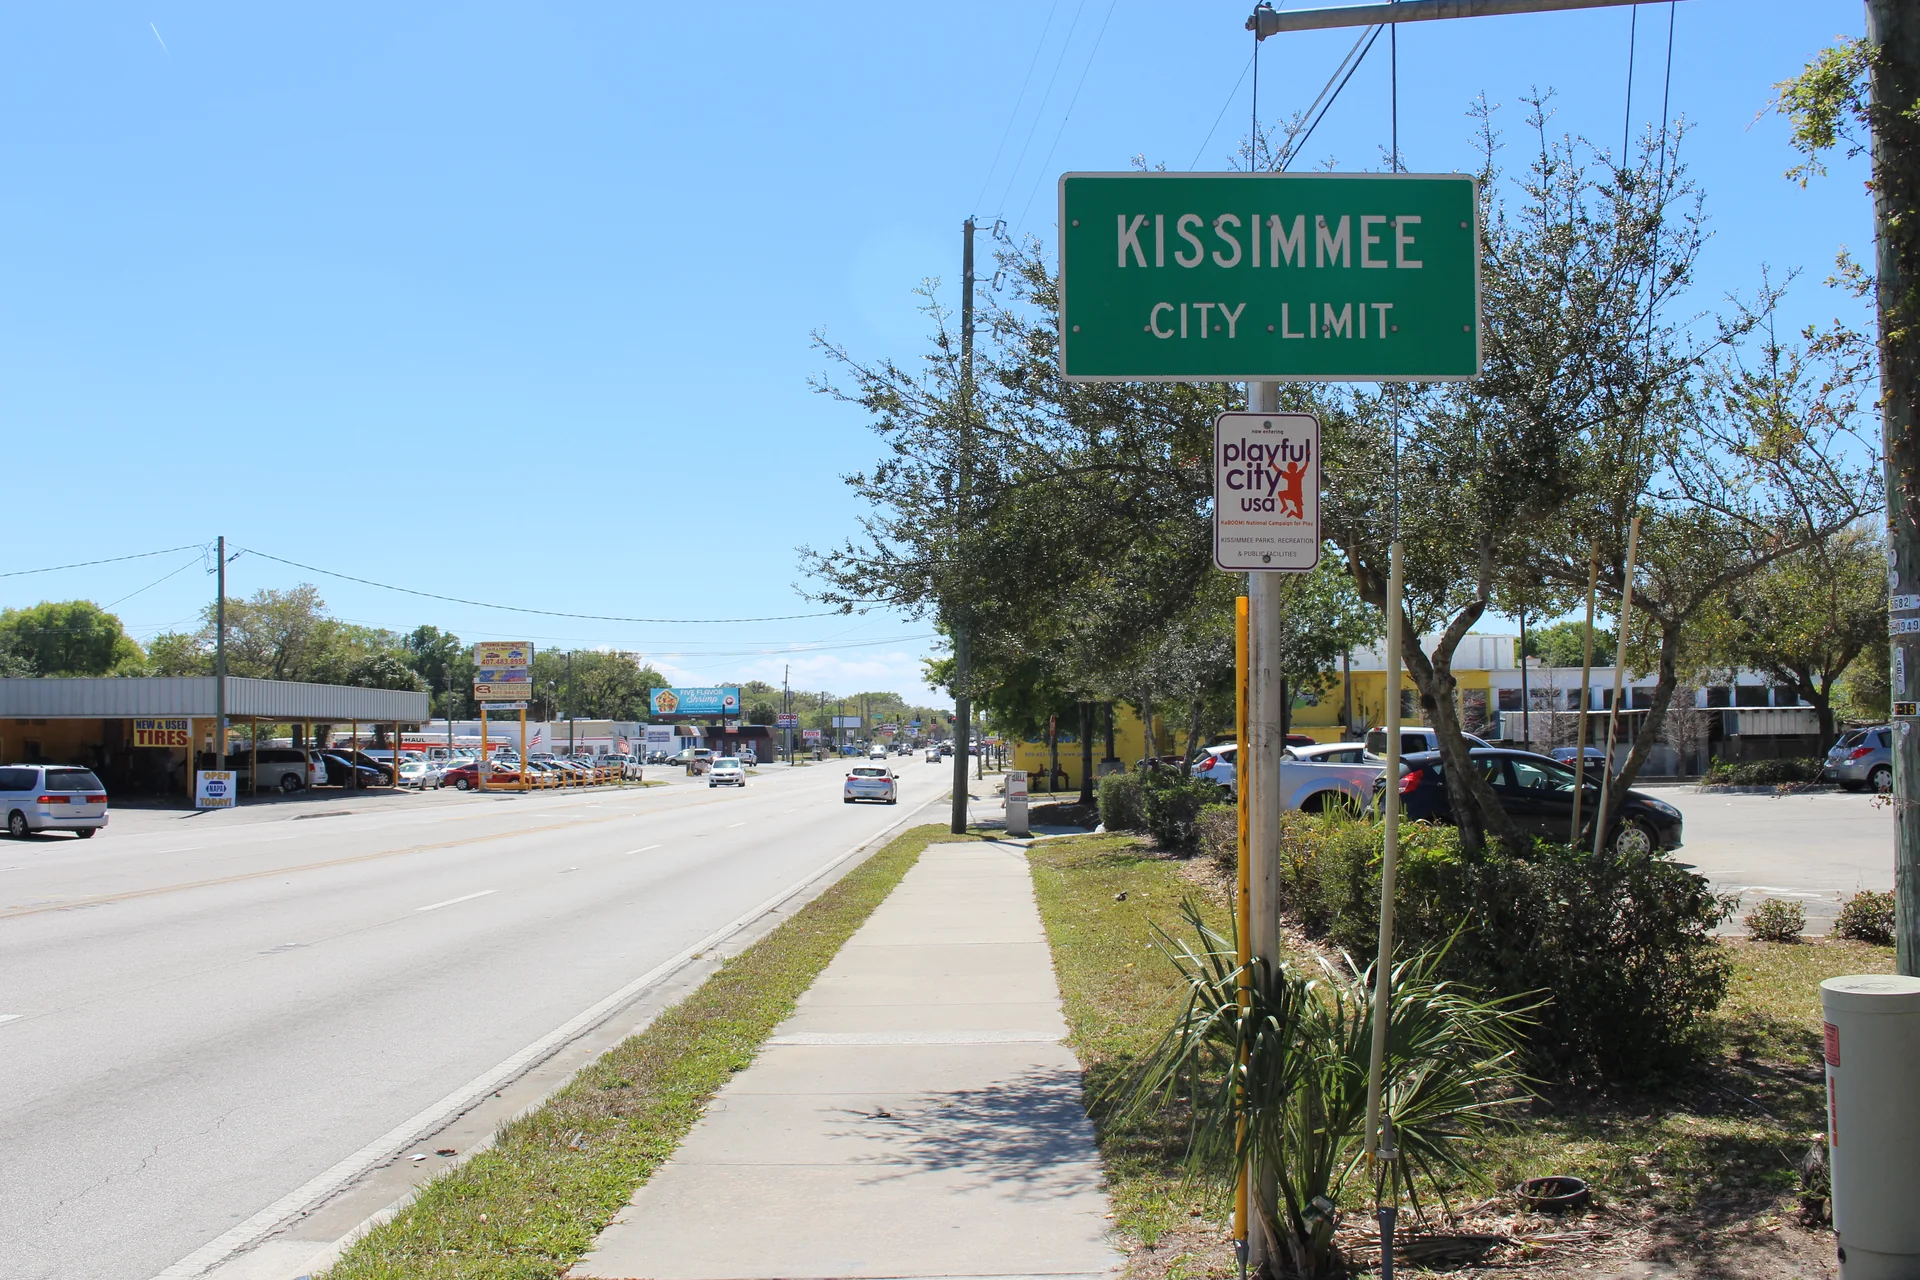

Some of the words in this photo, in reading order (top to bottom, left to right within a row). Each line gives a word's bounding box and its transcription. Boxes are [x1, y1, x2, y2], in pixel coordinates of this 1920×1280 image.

[1117, 214, 1423, 269] KISSIMMEE
[1149, 302, 1247, 339] CITY
[1281, 303, 1394, 339] LIMIT
[1223, 438, 1311, 467] playful
[1226, 462, 1284, 497] city
[1240, 498, 1275, 513] usa
[686, 694, 718, 704] Shrimp
[136, 720, 155, 729] NEW
[157, 721, 163, 729] &
[165, 720, 188, 729] USED
[136, 730, 188, 745] TIRES
[203, 772, 231, 780] OPEN
[200, 797, 233, 807] TODAY!
